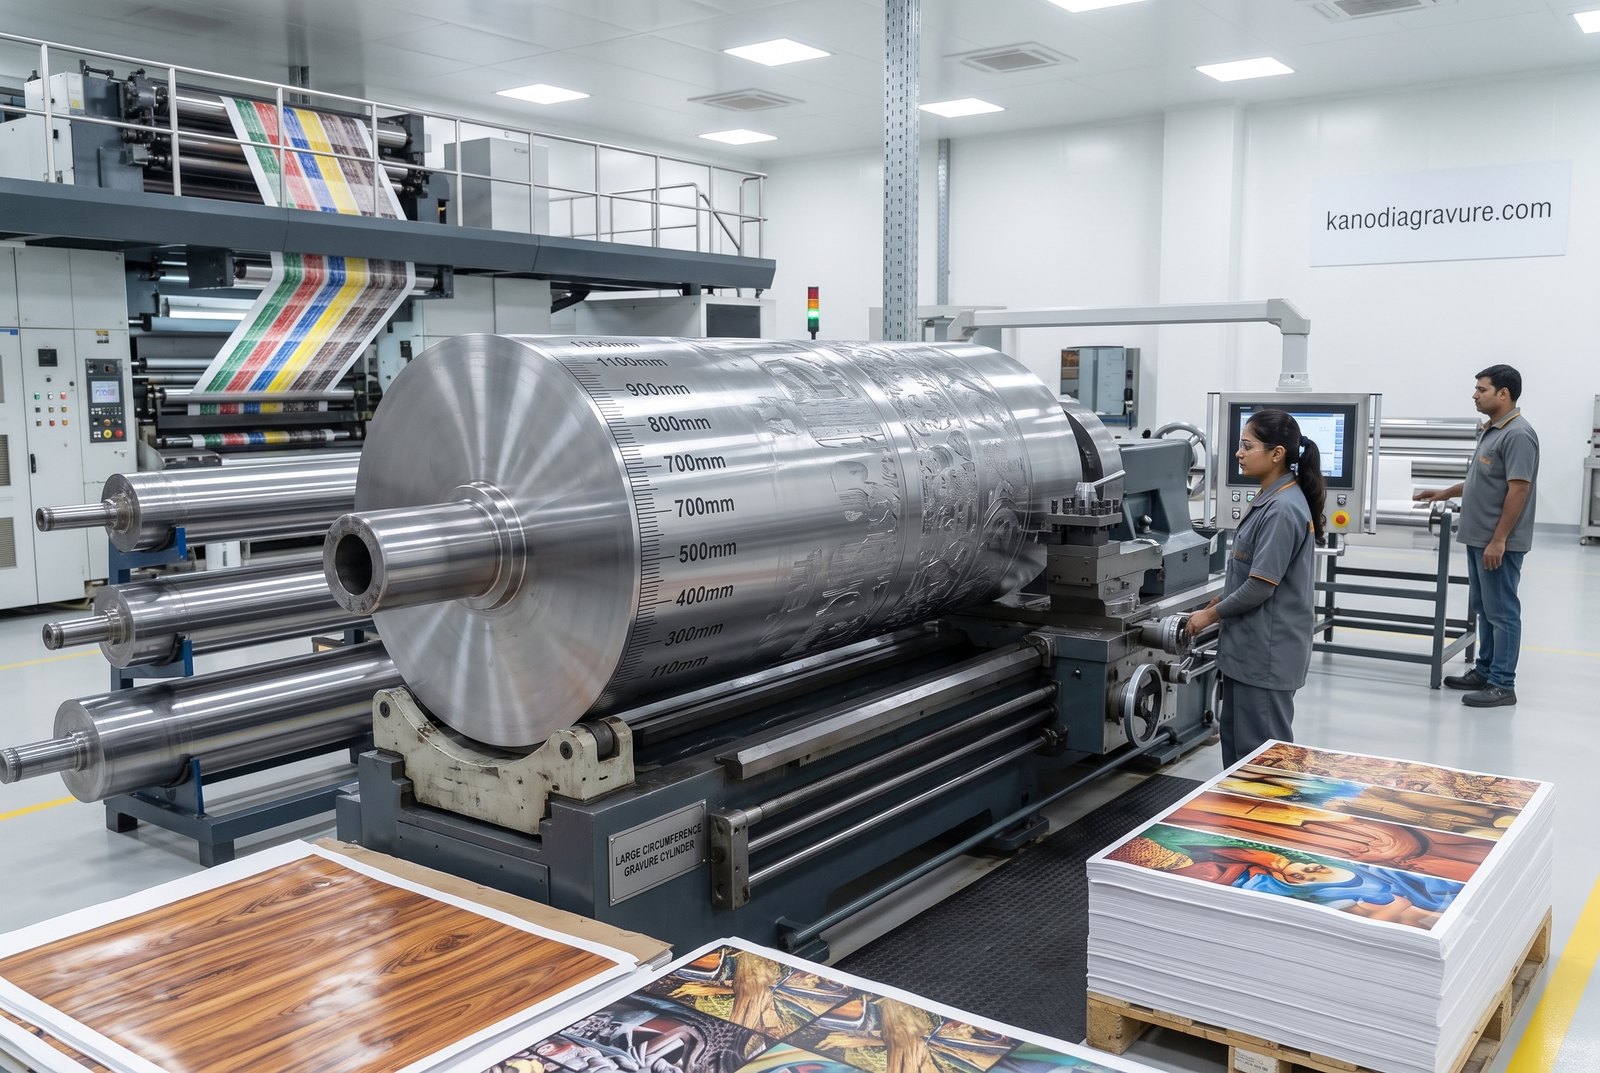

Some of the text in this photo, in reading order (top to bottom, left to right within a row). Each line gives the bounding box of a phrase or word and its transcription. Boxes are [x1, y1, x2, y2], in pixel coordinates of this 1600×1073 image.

[1326, 201, 1552, 231] kanodiagravure.com
[597, 357, 668, 367] 1100mm
[625, 383, 691, 397] 900mm
[647, 416, 712, 433] 800mm
[664, 454, 726, 473] 700mm
[674, 497, 735, 518] 700mm
[679, 541, 737, 563] 500mm
[675, 584, 734, 607] 400mm
[665, 623, 724, 647] 300mm
[650, 655, 709, 679] 110mm
[615, 822, 702, 866] LARGE CIRCUMFERENCE
[624, 839, 695, 877] GRAVURE CYLINDER
